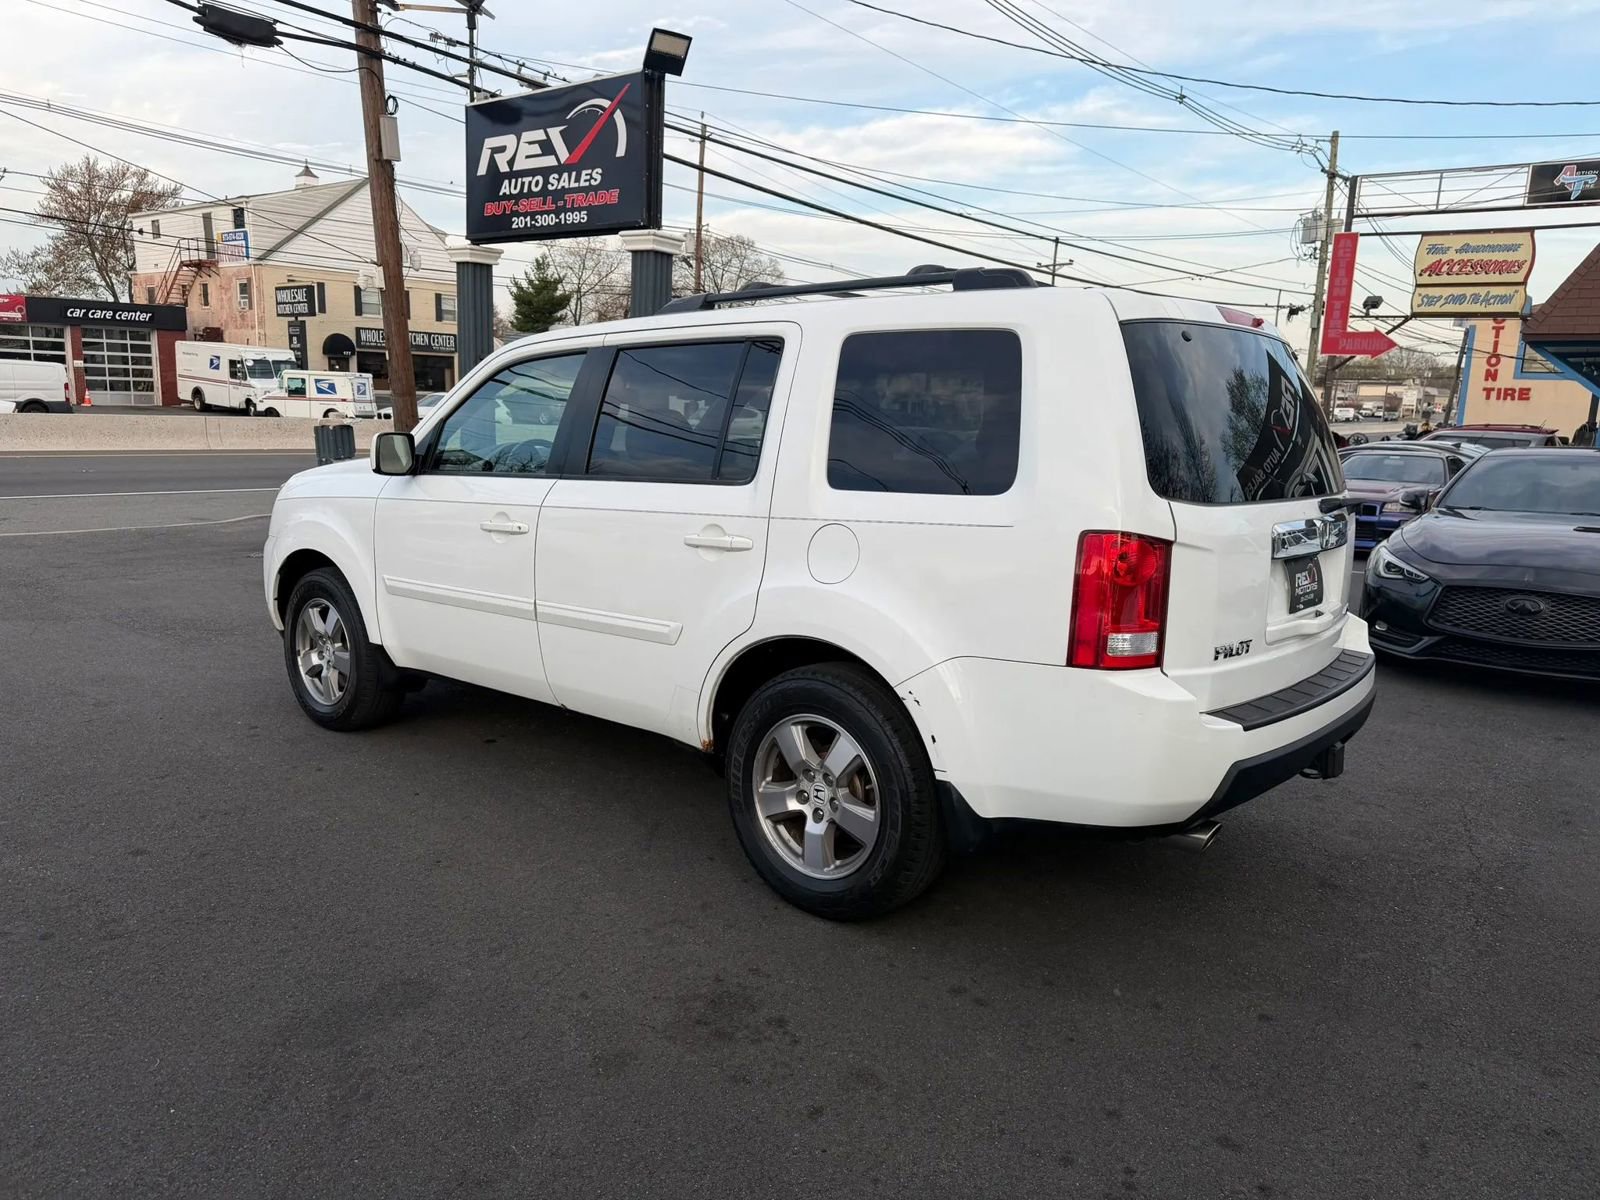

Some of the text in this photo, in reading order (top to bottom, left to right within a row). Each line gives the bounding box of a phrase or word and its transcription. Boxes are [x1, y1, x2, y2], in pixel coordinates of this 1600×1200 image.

[499, 168, 602, 196] AUTO SALES
[511, 211, 588, 228] 201-300-1995
[1418, 258, 1527, 276] ACCESSORIES
[276, 288, 307, 303] WHOLESALE
[67, 307, 152, 322] car care center
[277, 303, 309, 314] KITCHEN CENTER
[409, 332, 429, 346] TCHEN
[430, 333, 455, 348] CENTER
[1482, 387, 1531, 401] TIRE
[1213, 639, 1253, 661] PILOT
